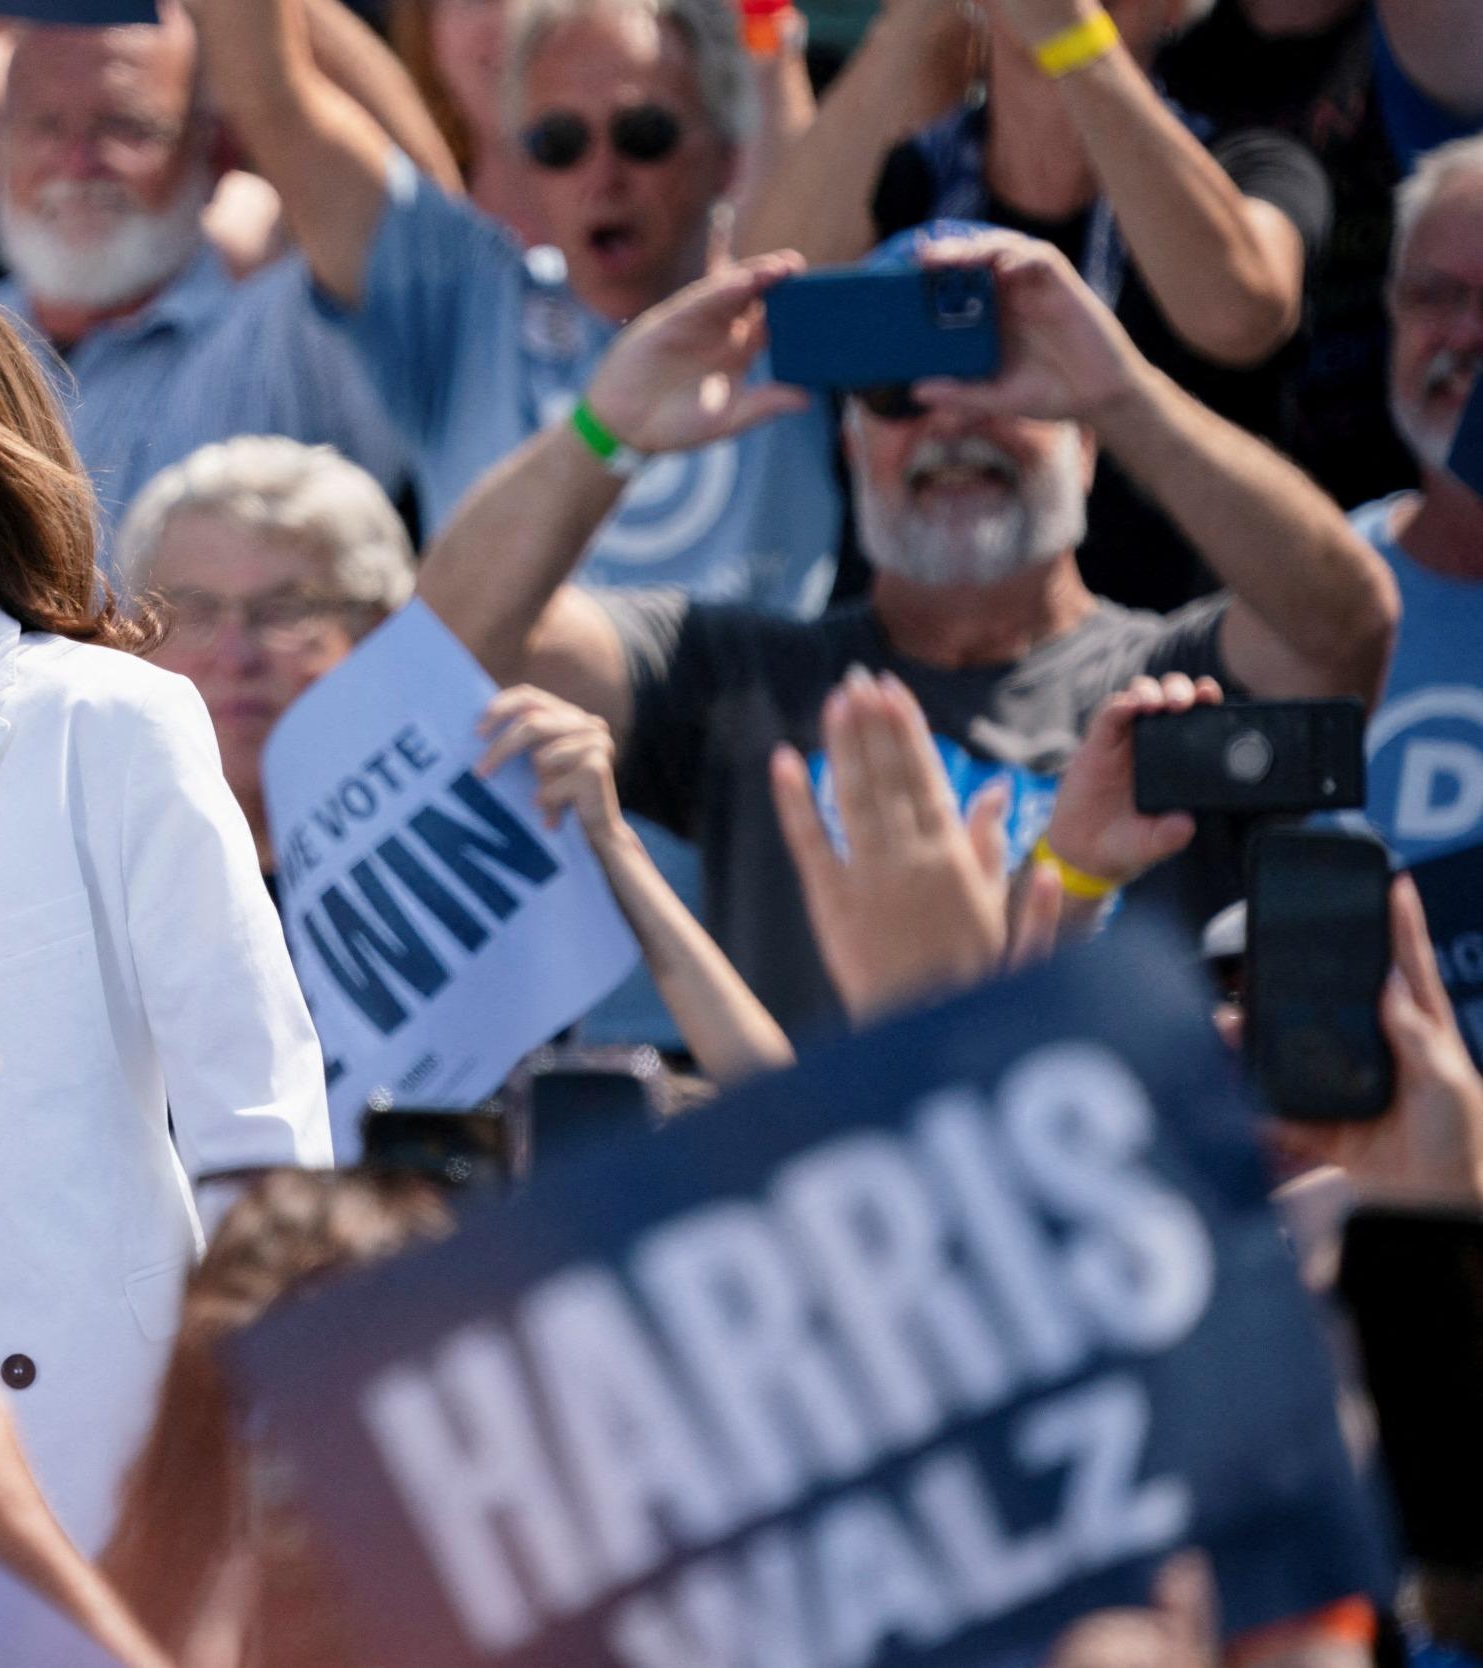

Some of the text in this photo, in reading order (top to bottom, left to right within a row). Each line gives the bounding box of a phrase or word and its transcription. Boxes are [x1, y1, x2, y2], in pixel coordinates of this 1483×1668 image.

[302, 767, 561, 1038] WIN
[311, 723, 441, 840] VOTE
[363, 1038, 1215, 1658] HARRIS
